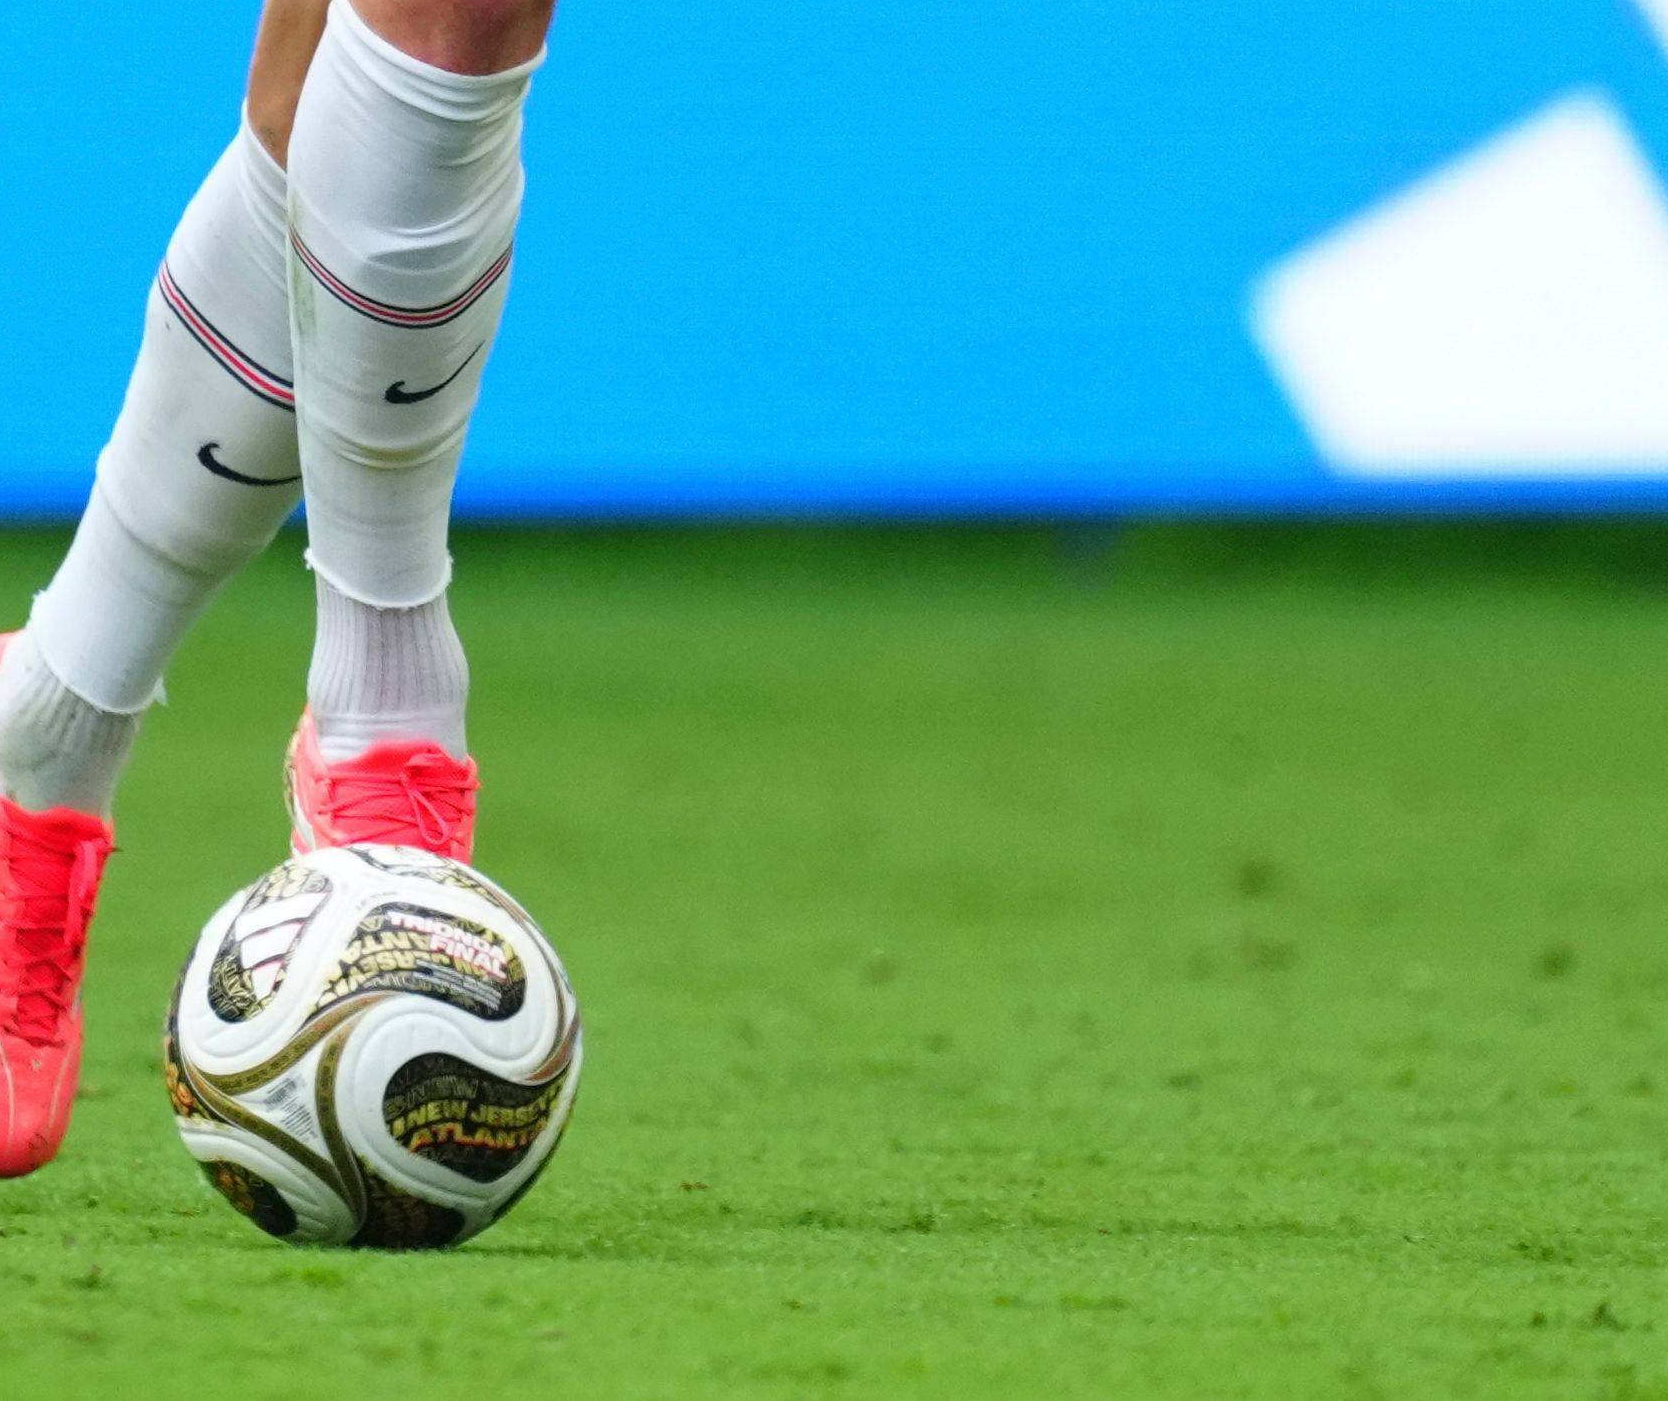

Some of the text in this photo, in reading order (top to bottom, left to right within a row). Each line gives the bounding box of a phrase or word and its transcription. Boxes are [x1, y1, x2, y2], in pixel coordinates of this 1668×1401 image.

[386, 911, 508, 965] TRIONDA
[430, 933, 508, 982] FINAL
[407, 1100, 468, 1129] NEW
